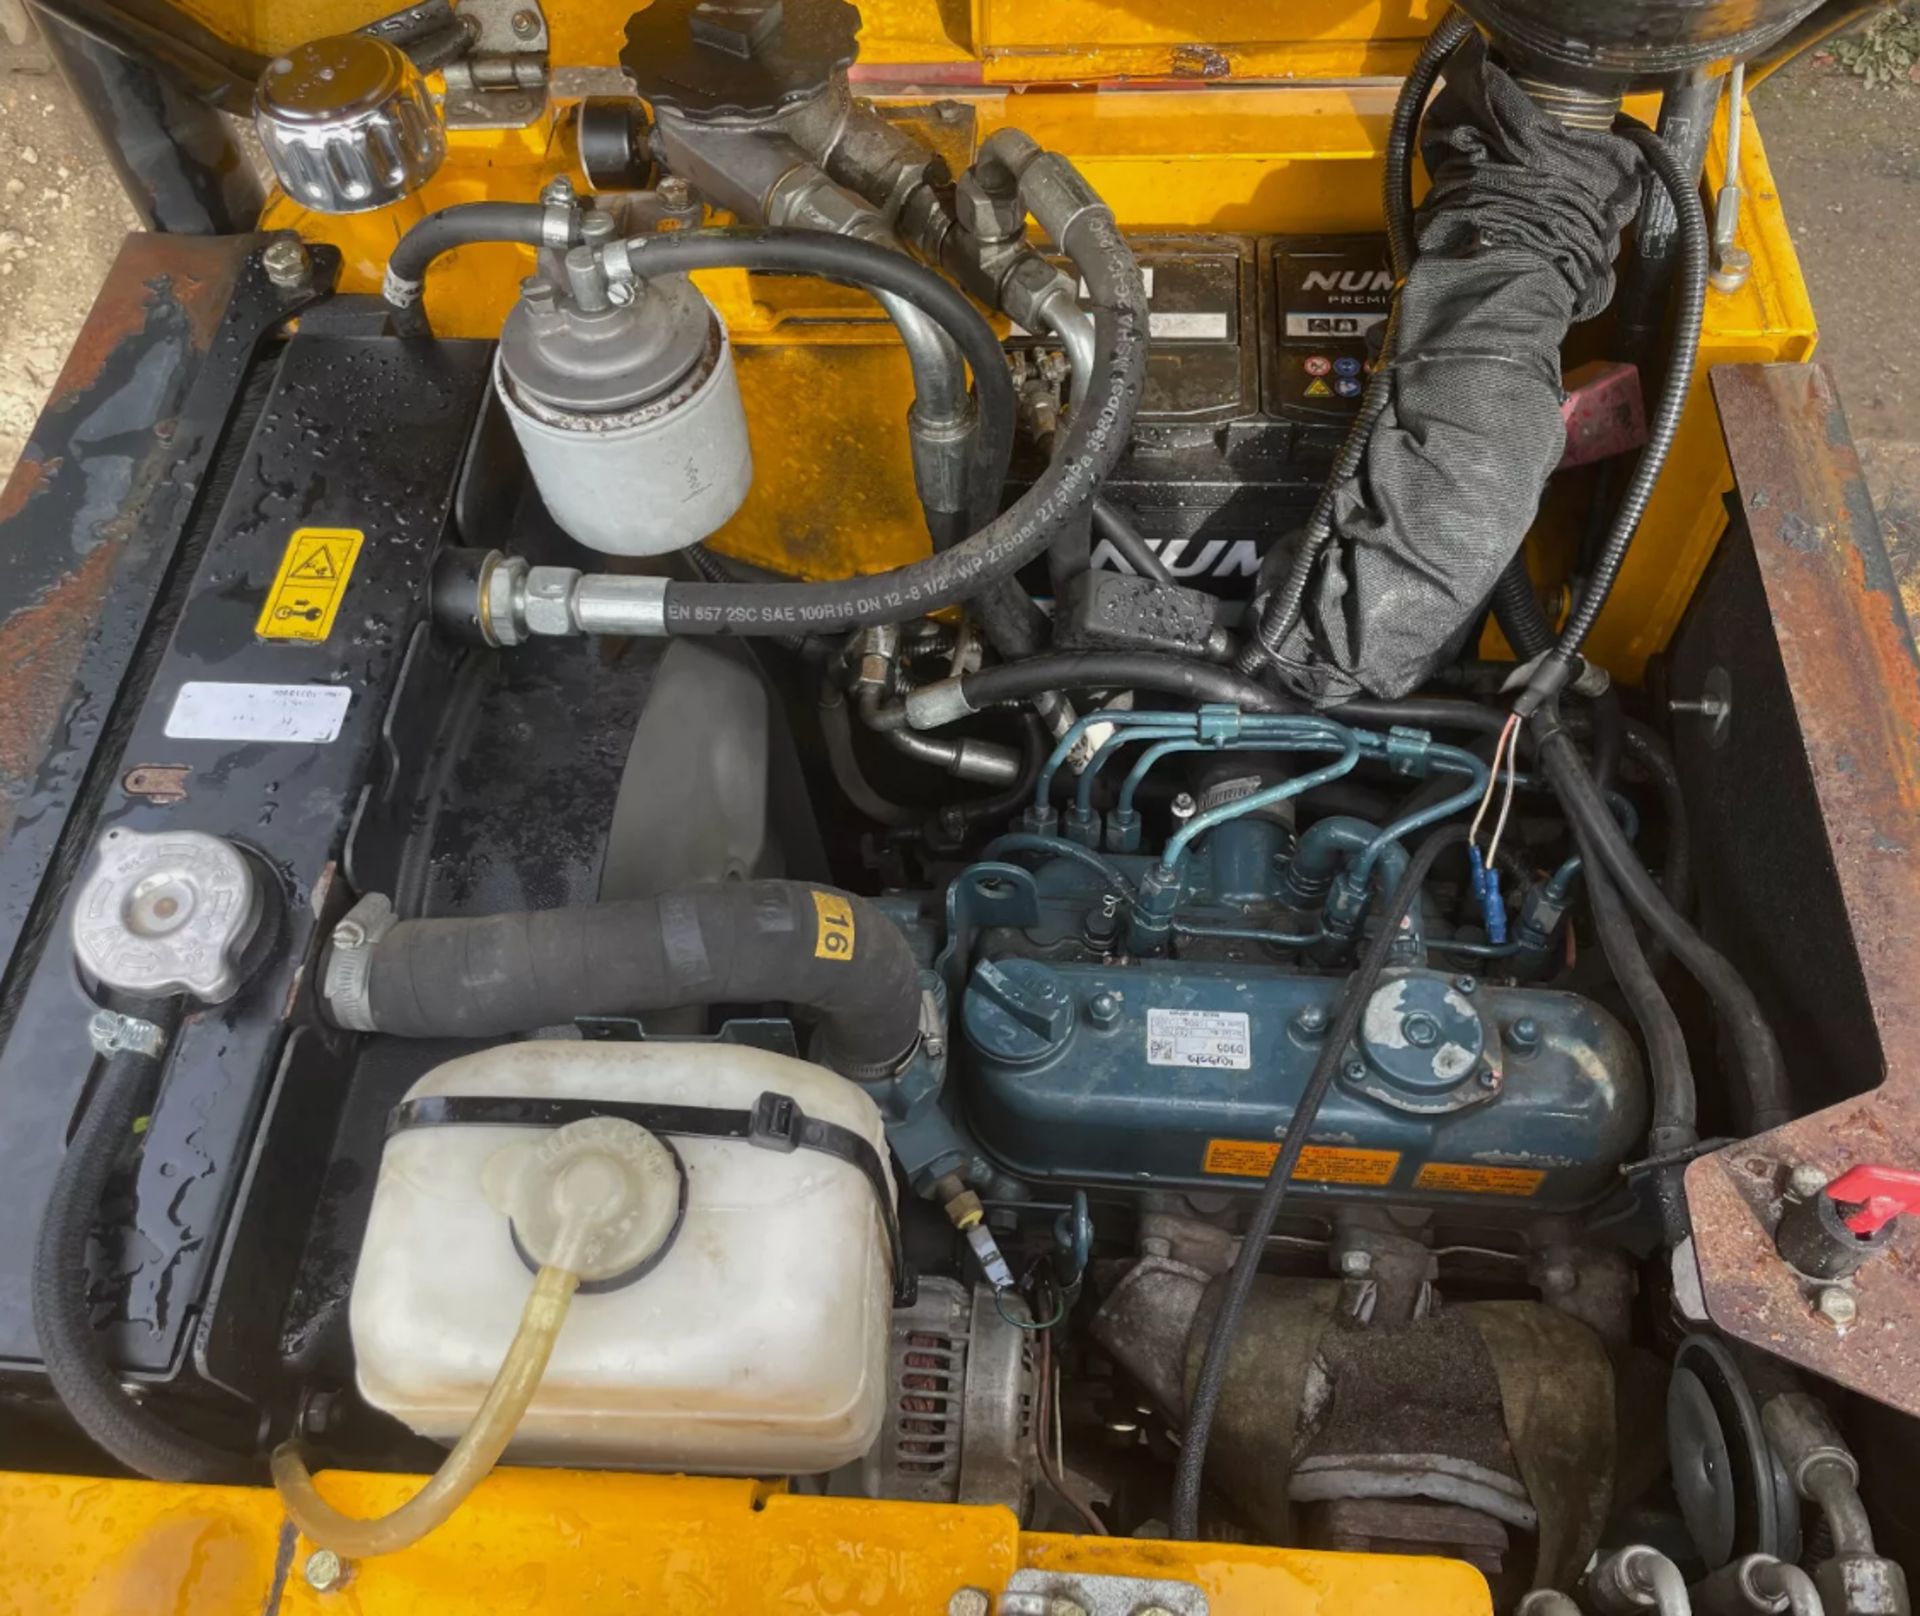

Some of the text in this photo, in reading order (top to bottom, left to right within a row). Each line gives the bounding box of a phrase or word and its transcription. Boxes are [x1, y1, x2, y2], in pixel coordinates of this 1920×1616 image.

[668, 604, 690, 620] EN
[726, 606, 757, 622] 2SC
[761, 607, 796, 622] SAE
[799, 602, 854, 621] 100R16
[857, 597, 882, 613] DN
[985, 520, 1038, 564] 275bar
[1036, 454, 1094, 522] 27.5MPa
[1086, 376, 1126, 452] 3980psi
[824, 914, 850, 954] 16
